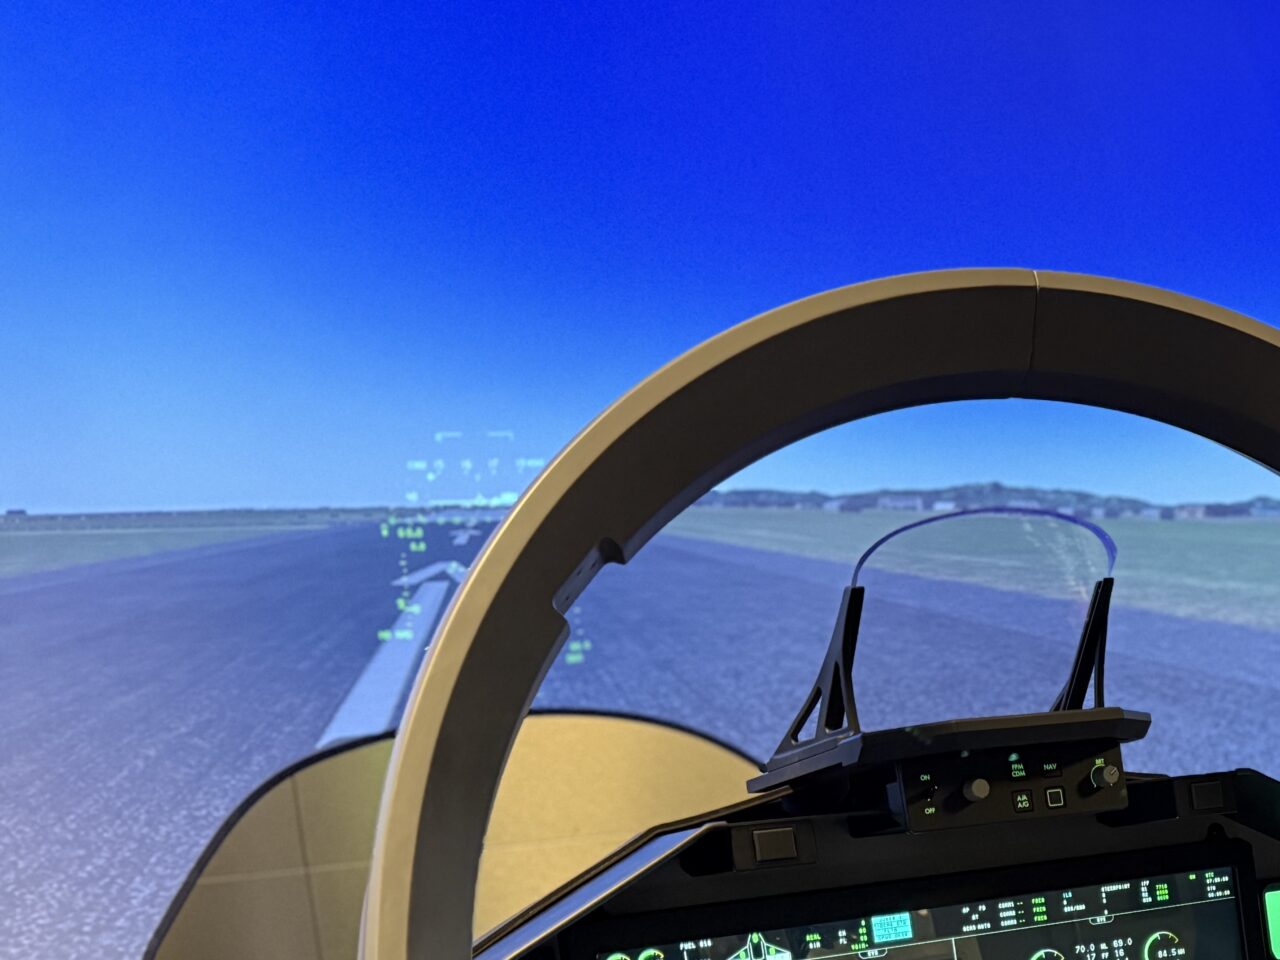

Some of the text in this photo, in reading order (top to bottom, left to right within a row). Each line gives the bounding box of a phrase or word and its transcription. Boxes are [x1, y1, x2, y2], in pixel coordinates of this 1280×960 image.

[1044, 763, 1057, 771] NAV
[920, 773, 931, 782] ON
[924, 807, 936, 815] OFF
[1075, 944, 1095, 954] 70.0
[1114, 949, 1124, 957] 16
